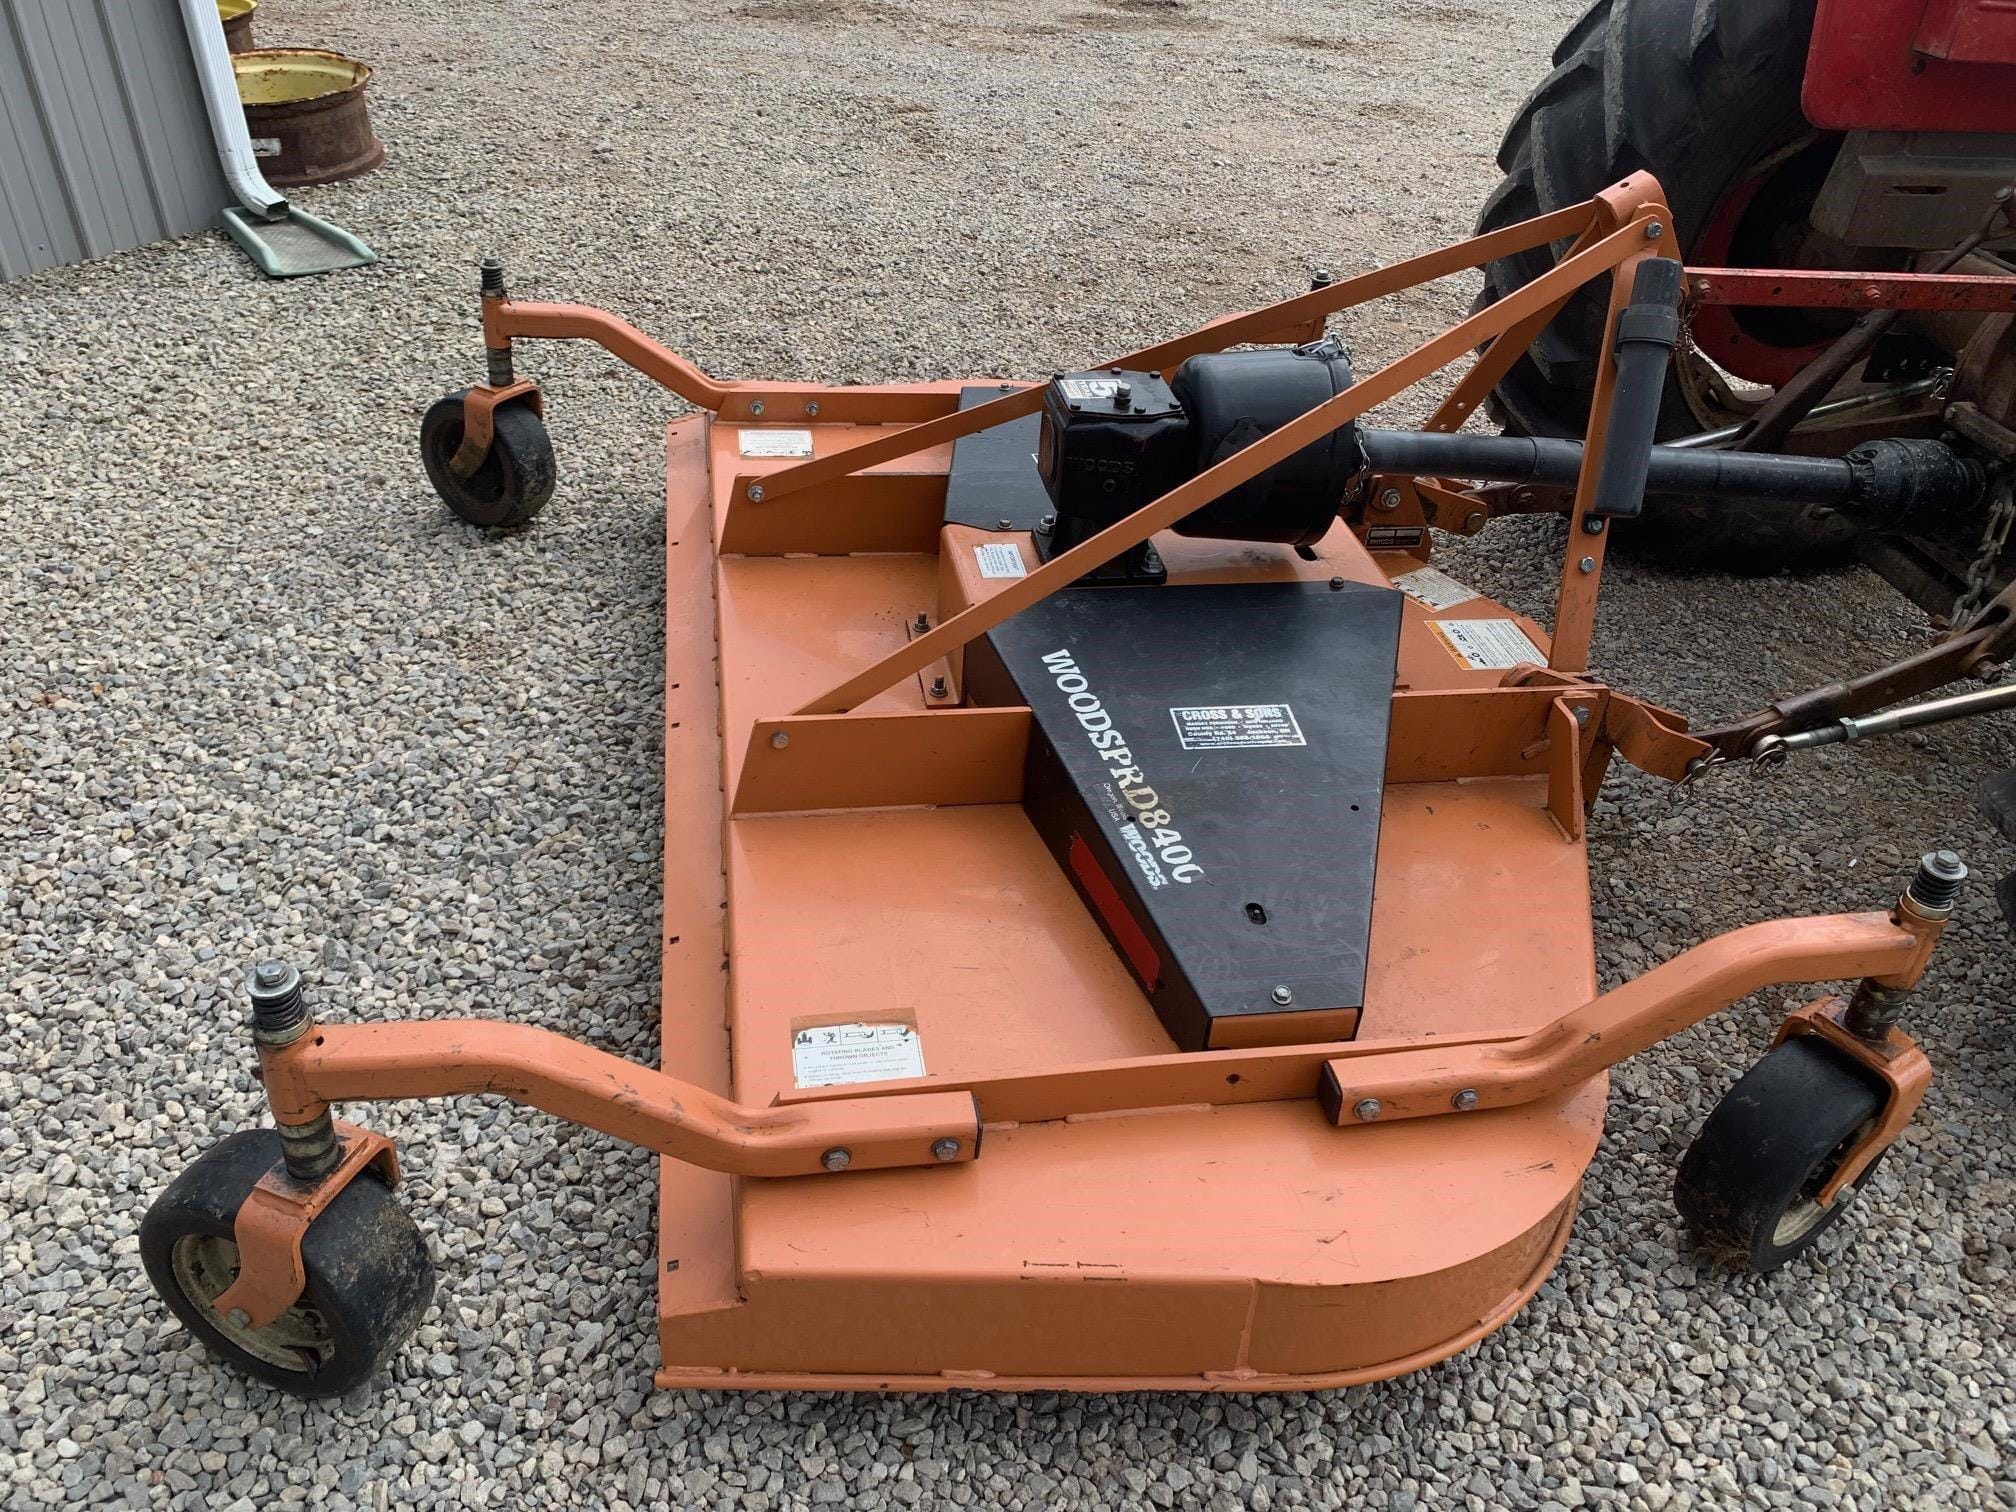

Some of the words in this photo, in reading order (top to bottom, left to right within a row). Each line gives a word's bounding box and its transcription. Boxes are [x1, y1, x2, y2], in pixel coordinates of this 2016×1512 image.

[1182, 709, 1228, 721] CROSS
[1231, 709, 1243, 719] &
[1244, 707, 1282, 719] SONS
[1108, 808, 1120, 823] USA
[821, 1048, 854, 1056] ROTATING
